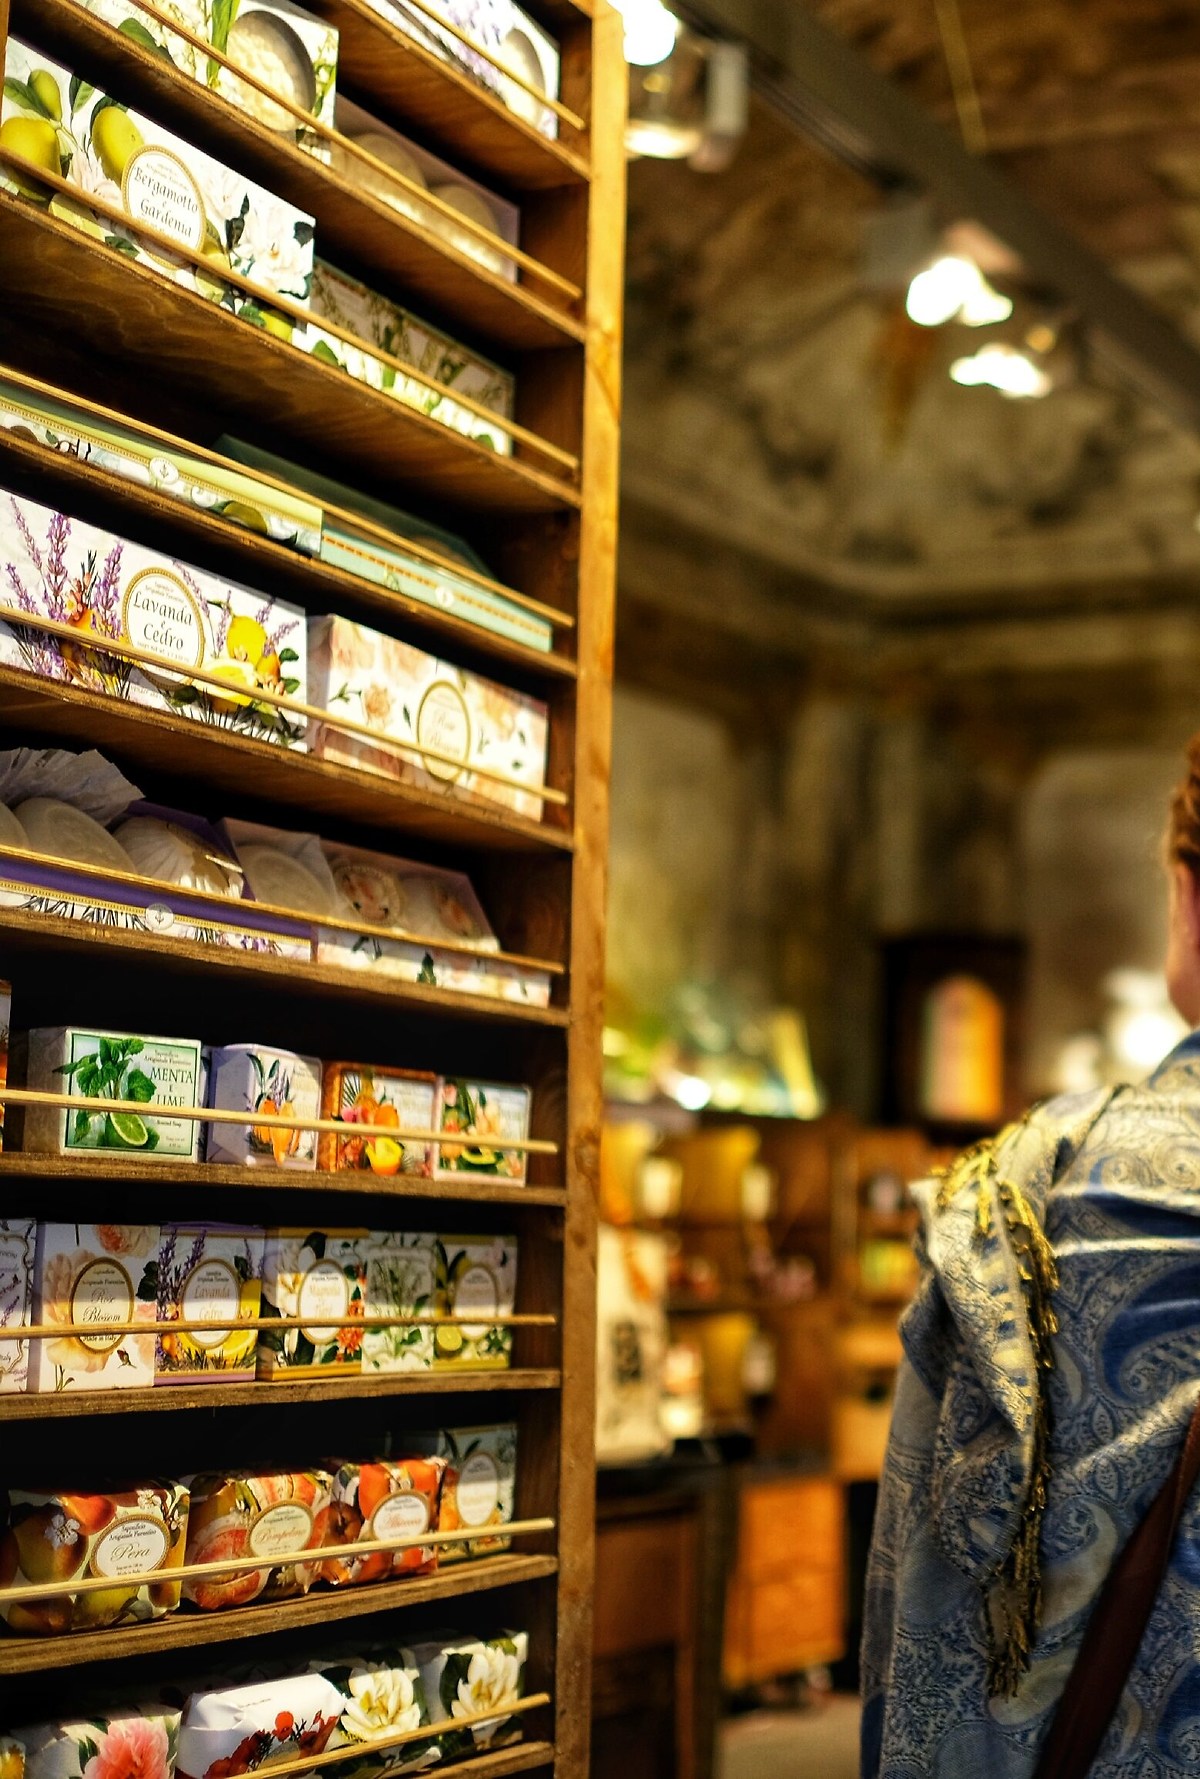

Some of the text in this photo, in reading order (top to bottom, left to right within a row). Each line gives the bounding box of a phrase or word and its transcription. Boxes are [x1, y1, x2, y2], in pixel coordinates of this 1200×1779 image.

[134, 167, 198, 213] Bergamotto
[140, 198, 192, 238] Gardenia
[133, 590, 192, 626] Lavanda
[160, 620, 166, 629] e
[143, 622, 184, 651] Cedro
[150, 1066, 193, 1084] MENTA
[91, 1287, 117, 1304] Rose
[194, 1284, 230, 1300] Lavanda
[82, 1306, 121, 1323] Blossom
[110, 1541, 151, 1562] Pera
